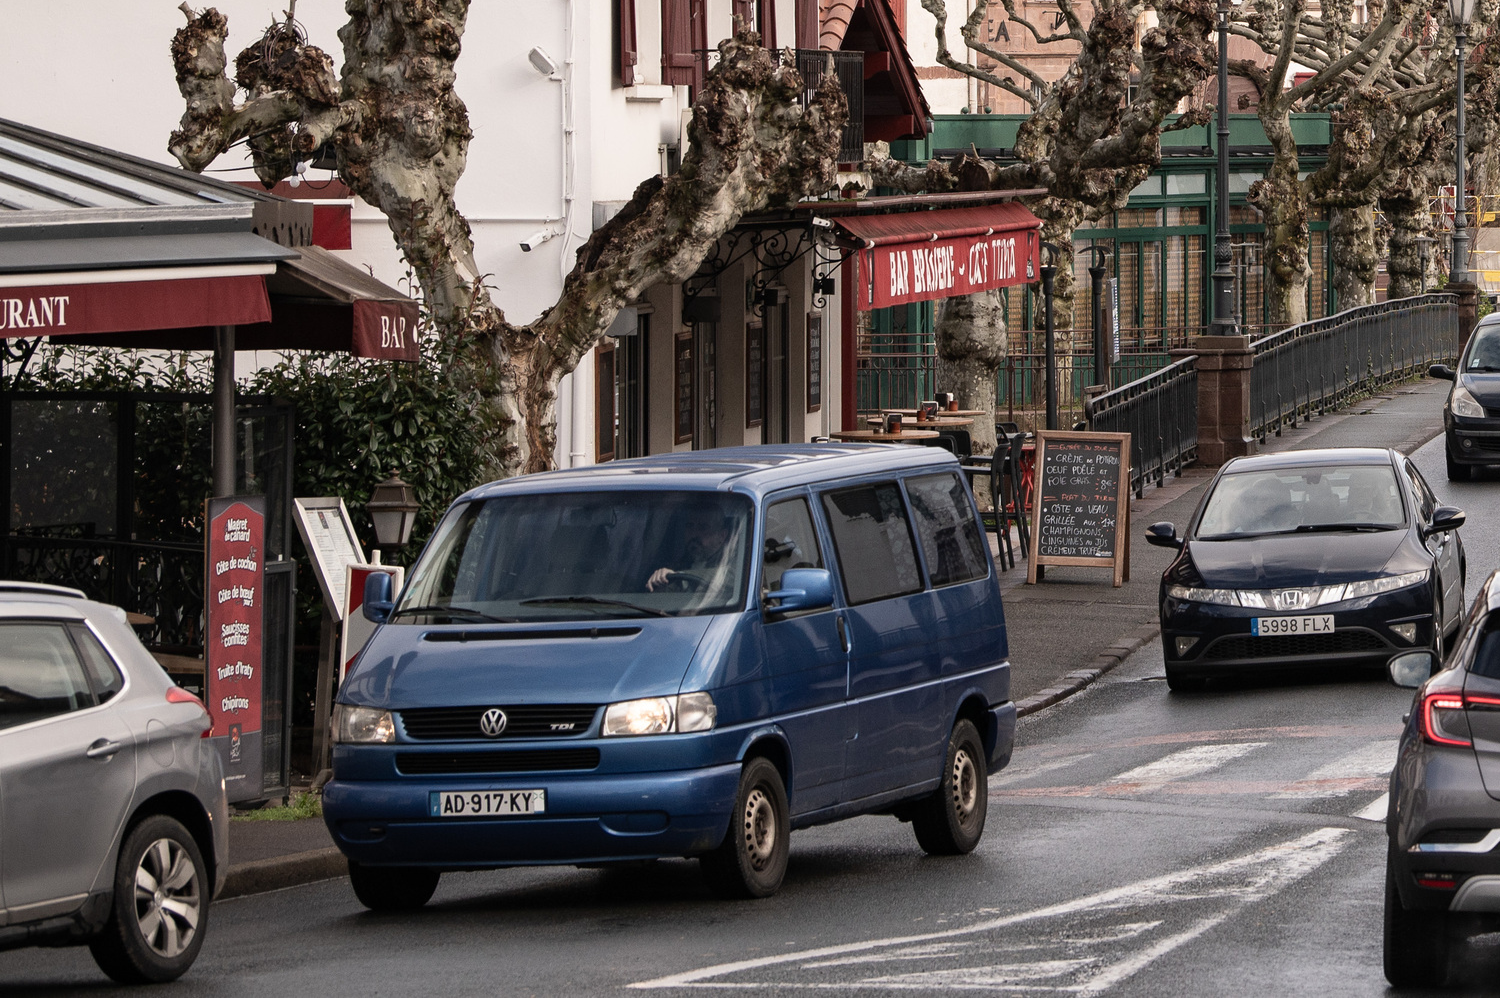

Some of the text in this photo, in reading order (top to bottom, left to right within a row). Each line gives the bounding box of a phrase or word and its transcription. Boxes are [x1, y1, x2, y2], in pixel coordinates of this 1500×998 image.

[890, 251, 909, 297] BAR
[381, 315, 406, 349] BAR
[1048, 476, 1067, 486] FOIE
[1088, 504, 1109, 514] VEAU
[227, 518, 248, 531] Magret
[230, 529, 250, 542] canard
[216, 556, 257, 575] Côte de cochon
[218, 589, 231, 604] Côte
[232, 585, 239, 599] de
[221, 620, 250, 636] Saucisses
[1261, 617, 1330, 633] 5998 FLX
[224, 631, 248, 648] confites
[217, 663, 235, 681] Truite
[222, 695, 249, 712] Chipirons
[550, 722, 575, 730] TDI
[443, 792, 532, 814] AD-917-KY
